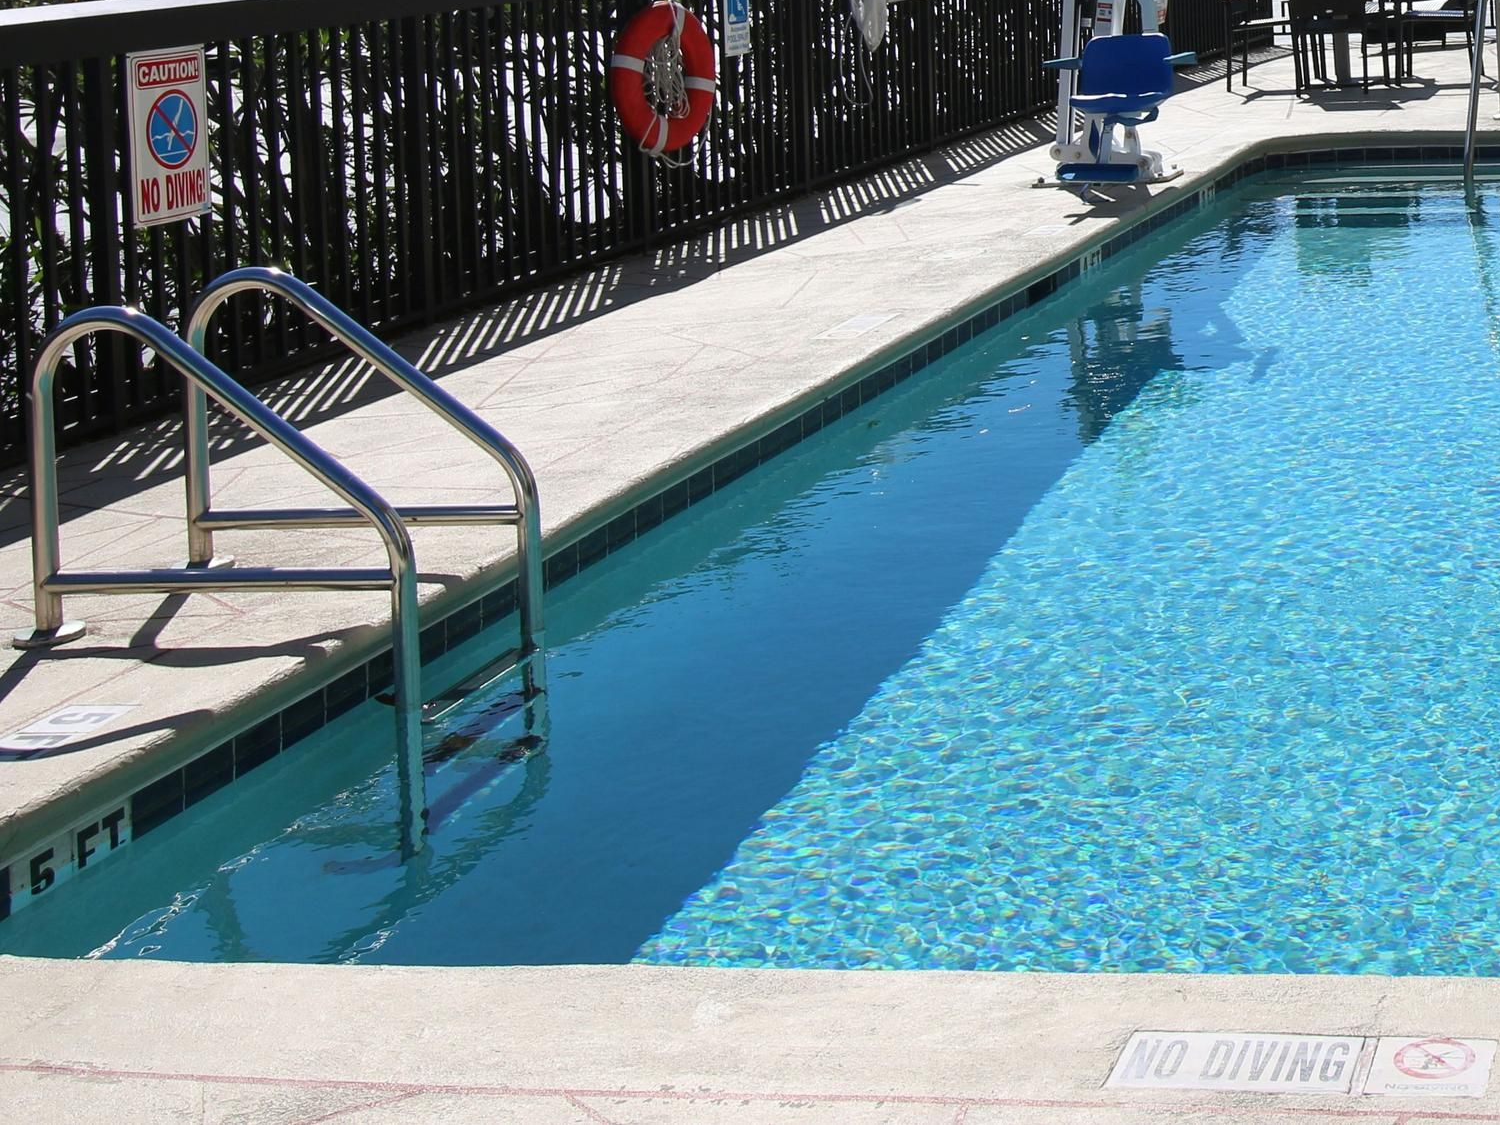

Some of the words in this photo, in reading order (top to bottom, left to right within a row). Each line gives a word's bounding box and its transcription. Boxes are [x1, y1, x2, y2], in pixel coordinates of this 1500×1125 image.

[139, 59, 199, 83] CAUTION!
[141, 177, 161, 215] NO
[165, 167, 206, 211] DIVING!
[30, 848, 55, 895] 5
[1119, 1038, 1189, 1080] NO
[1199, 1039, 1352, 1082] DIVING
[1384, 1082, 1409, 1090] NO
